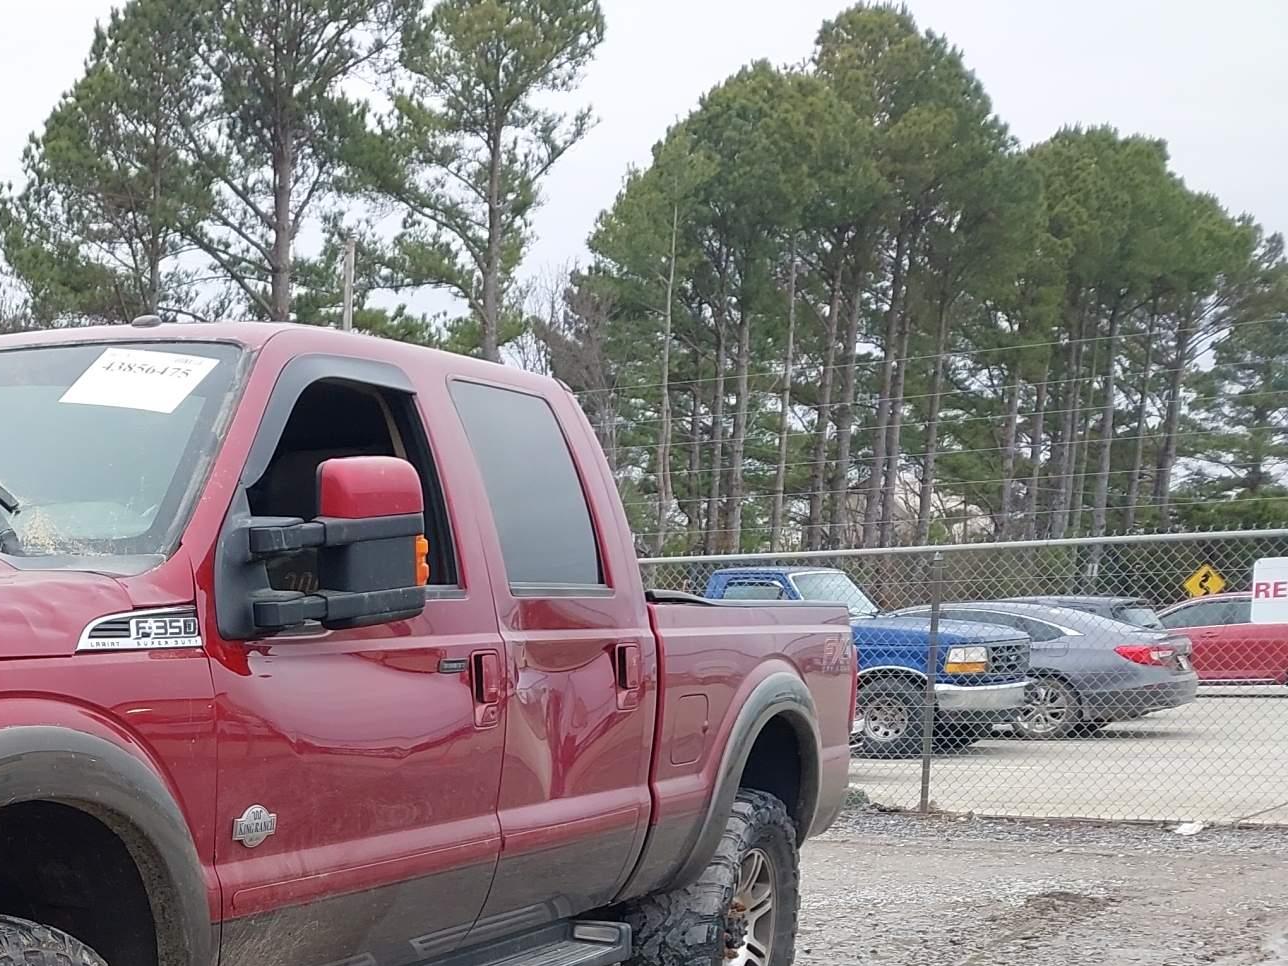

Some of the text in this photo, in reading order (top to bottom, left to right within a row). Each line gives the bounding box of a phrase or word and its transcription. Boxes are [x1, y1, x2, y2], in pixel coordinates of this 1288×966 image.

[102, 360, 193, 379] 43856475
[135, 619, 198, 637] F-350
[238, 819, 275, 836] KING RANCH
